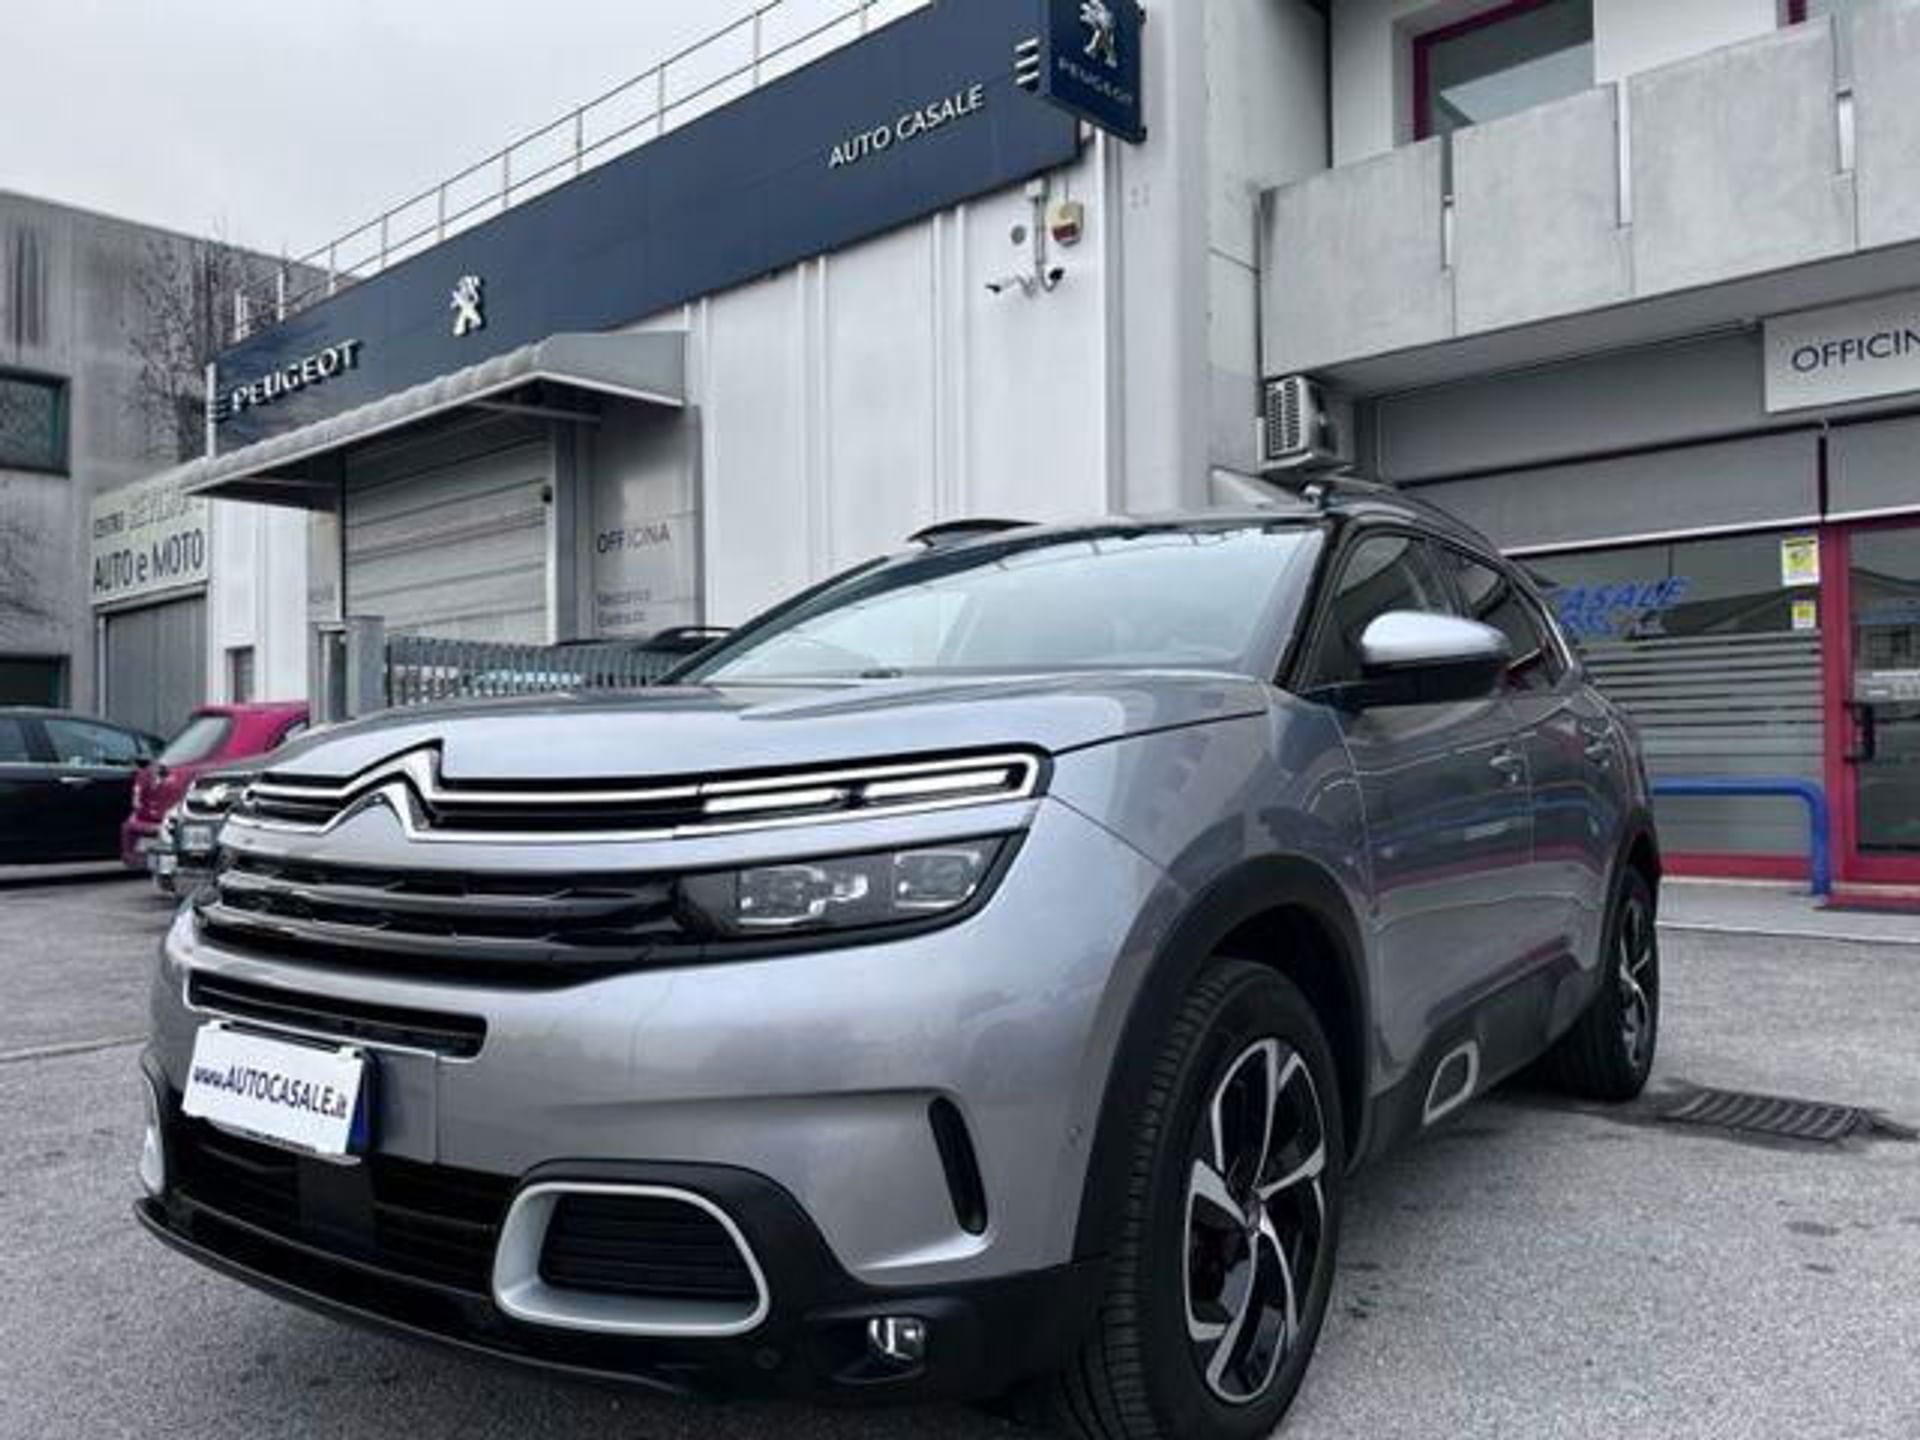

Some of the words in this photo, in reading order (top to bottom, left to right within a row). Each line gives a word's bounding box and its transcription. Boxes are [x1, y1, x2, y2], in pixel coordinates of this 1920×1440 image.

[828, 125, 892, 169] AUTO
[895, 83, 985, 140] CASALE
[230, 338, 362, 414] PEUGEOT
[93, 547, 134, 593] AUTO
[136, 551, 149, 584] e
[152, 527, 206, 579] MOTO
[596, 521, 672, 554] OFFICINA
[192, 1063, 347, 1120] www.AUTOCASALE.it
